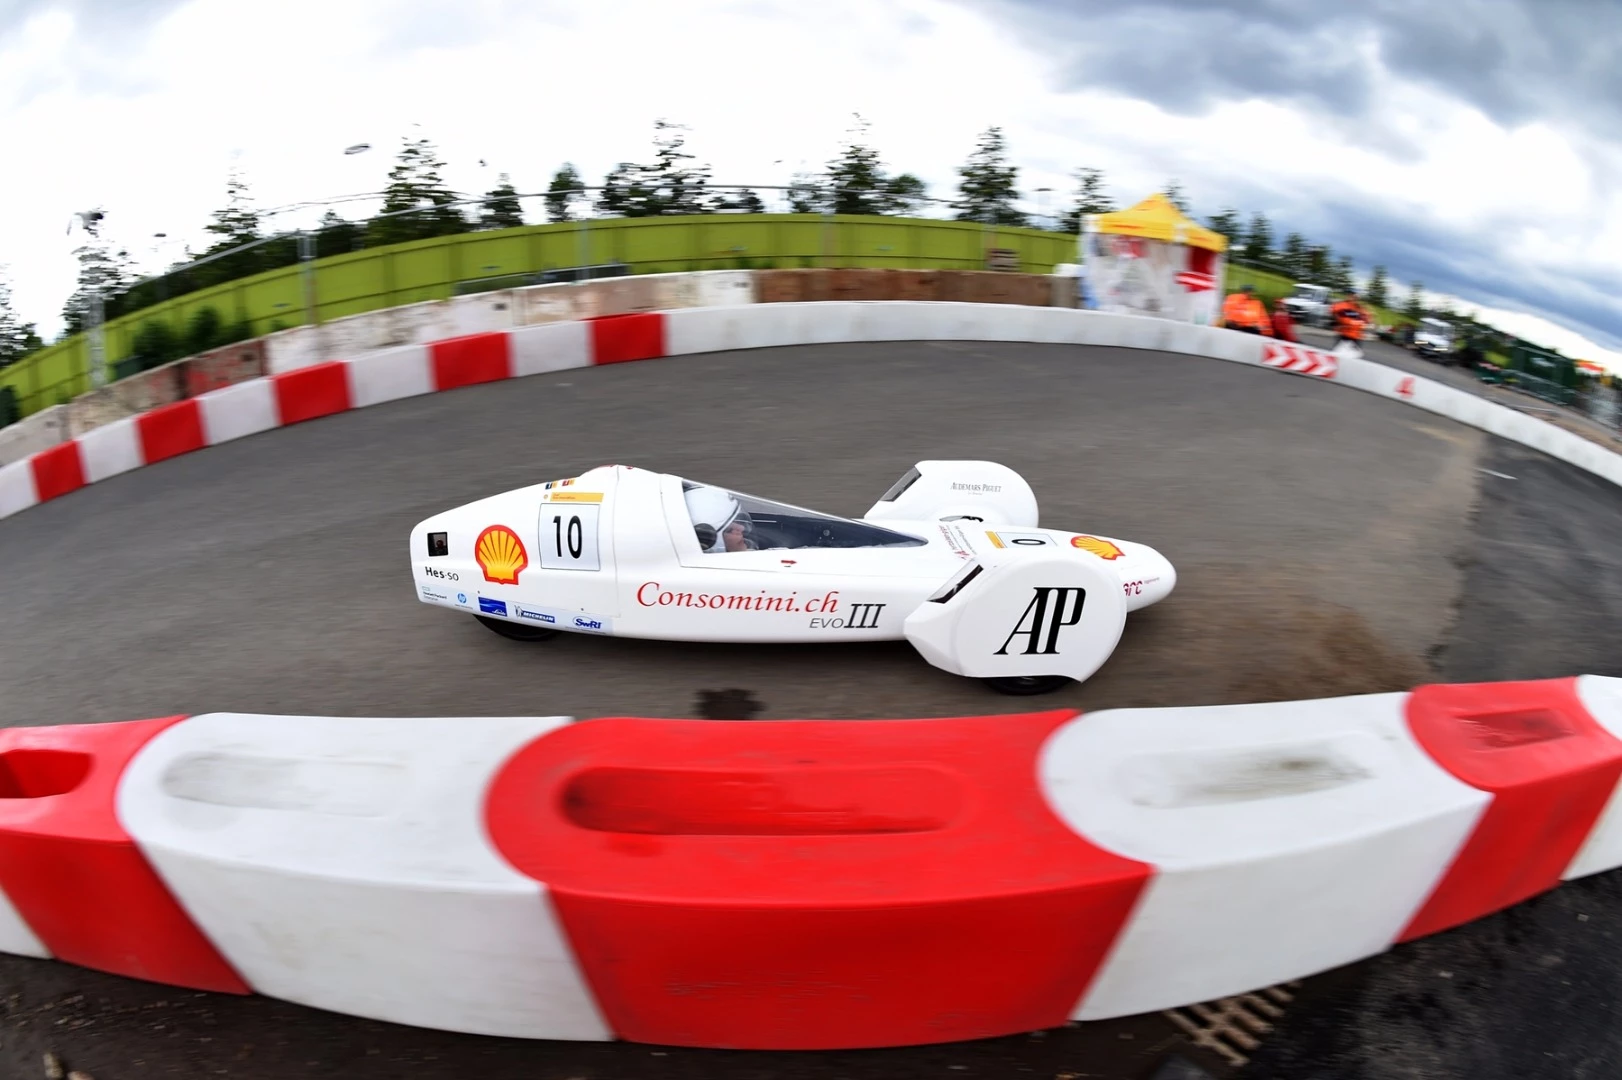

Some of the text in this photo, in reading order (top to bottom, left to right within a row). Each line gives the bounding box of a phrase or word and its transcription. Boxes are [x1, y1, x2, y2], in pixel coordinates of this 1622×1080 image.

[553, 515, 583, 559] 10
[637, 582, 840, 613] Consomini.ch
[523, 611, 554, 622] MICHELIN
[575, 618, 602, 629] SwRI
[809, 603, 887, 629] EVO III
[993, 587, 1087, 655] AP
